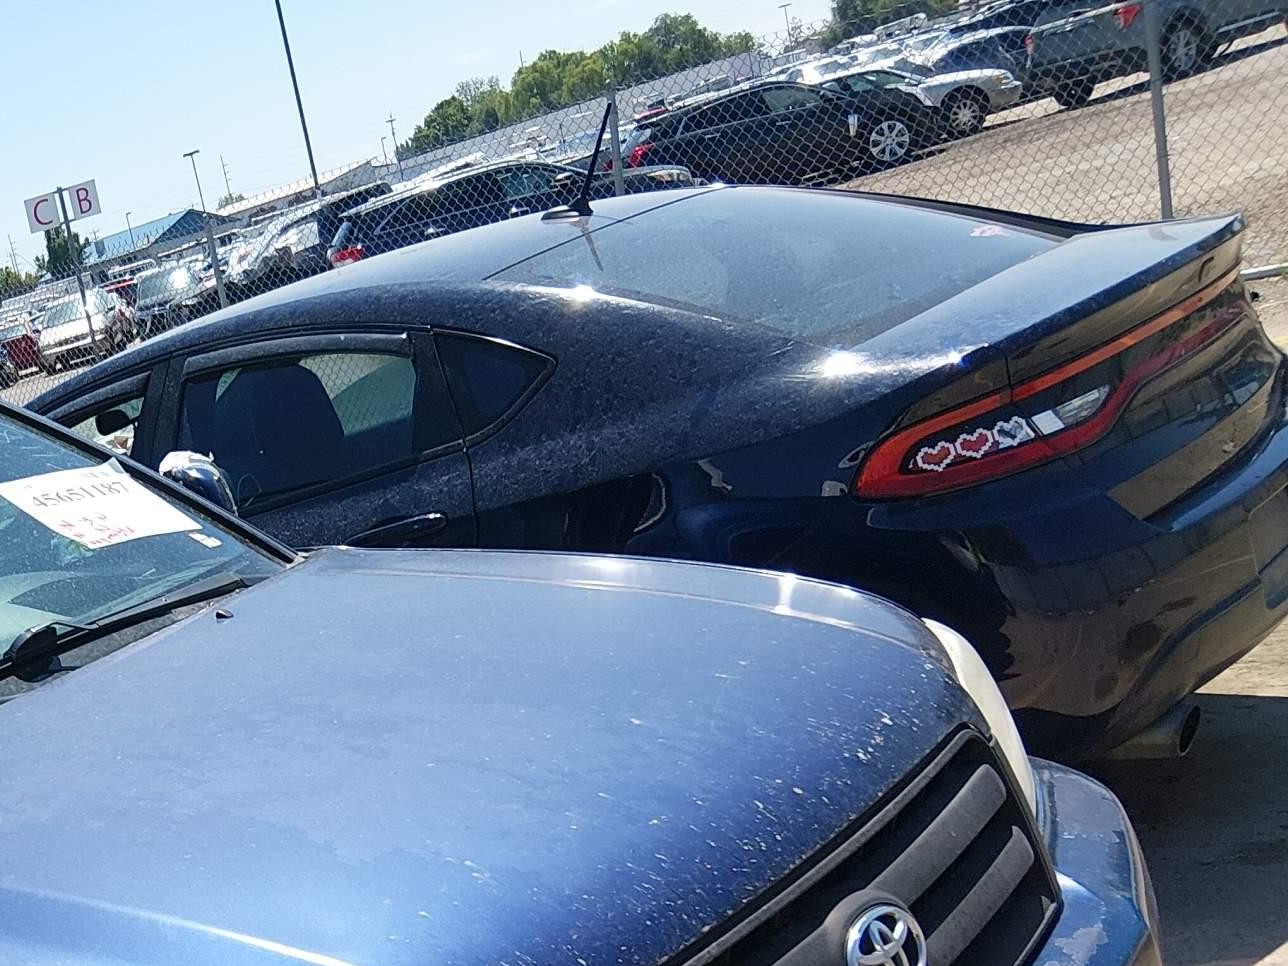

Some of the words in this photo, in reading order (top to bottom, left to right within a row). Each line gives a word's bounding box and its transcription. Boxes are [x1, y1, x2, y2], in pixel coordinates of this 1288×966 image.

[33, 198, 53, 226] C
[76, 187, 93, 215] B
[31, 481, 130, 508] 45651187
